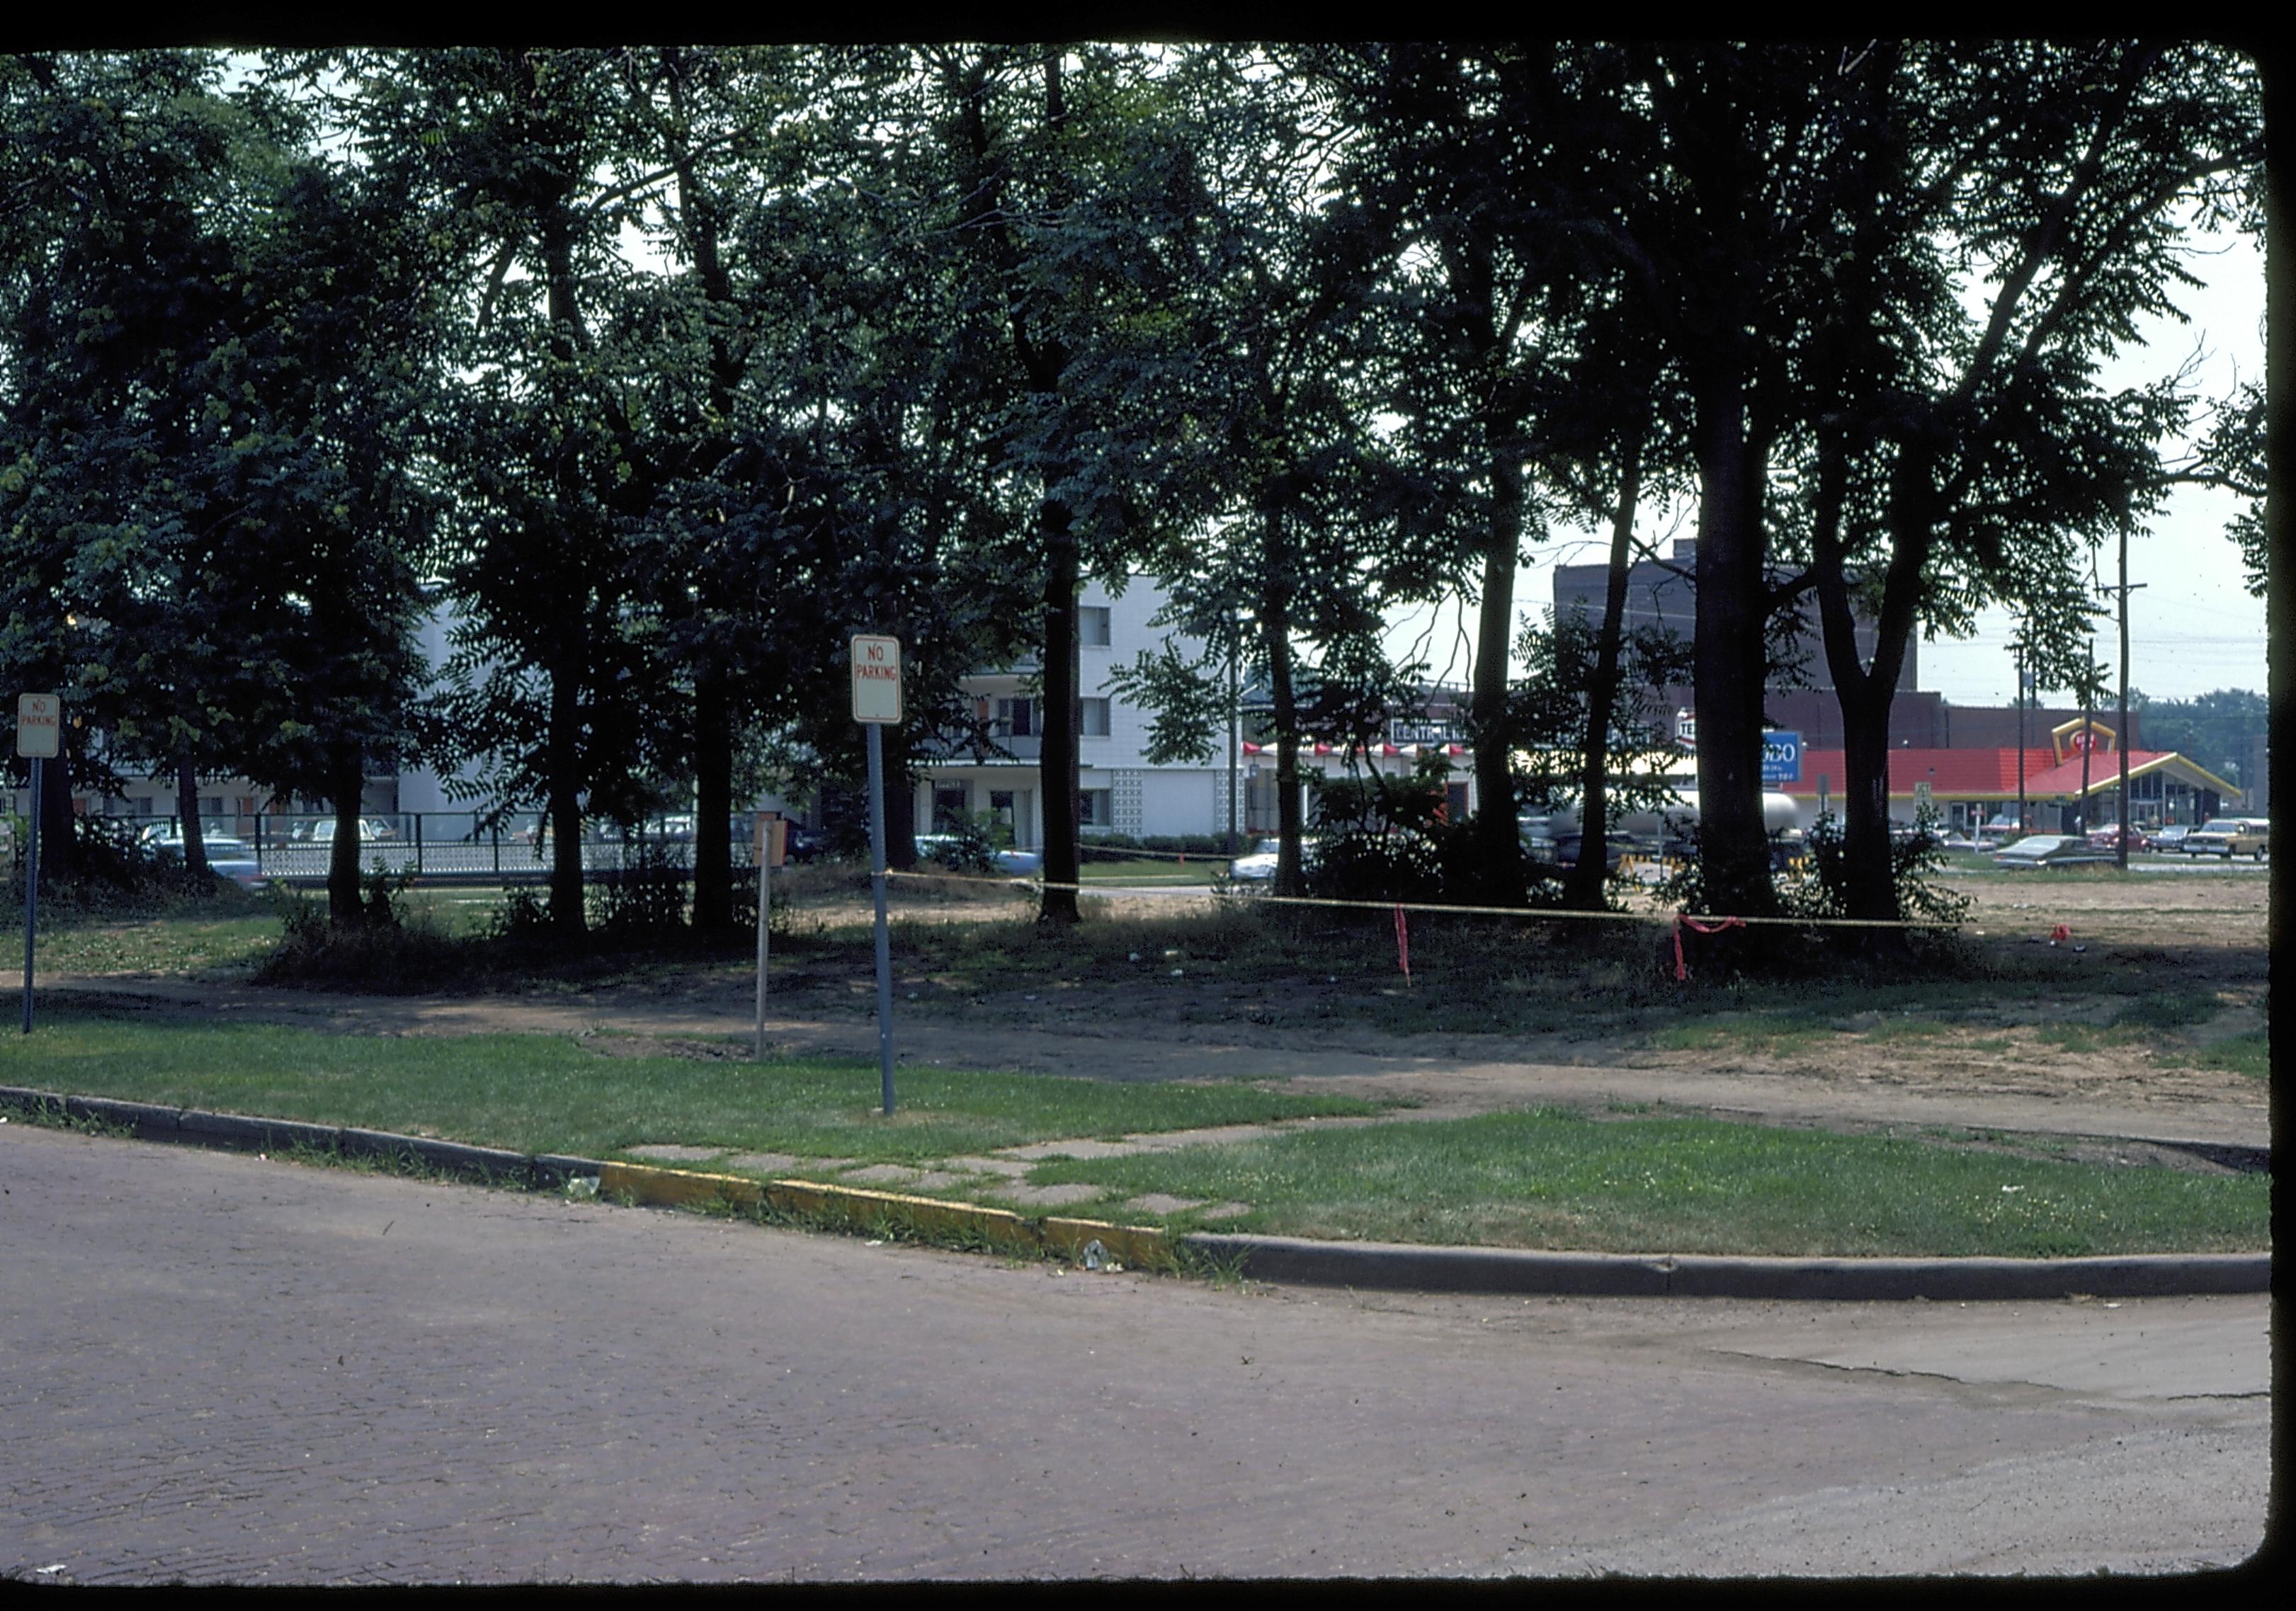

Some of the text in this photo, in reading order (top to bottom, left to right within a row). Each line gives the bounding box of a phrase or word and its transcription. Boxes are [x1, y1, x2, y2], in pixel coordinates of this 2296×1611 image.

[868, 646, 884, 661] NO
[856, 664, 896, 681] PARKING
[33, 702, 46, 713] NO
[22, 715, 56, 726] PARKING
